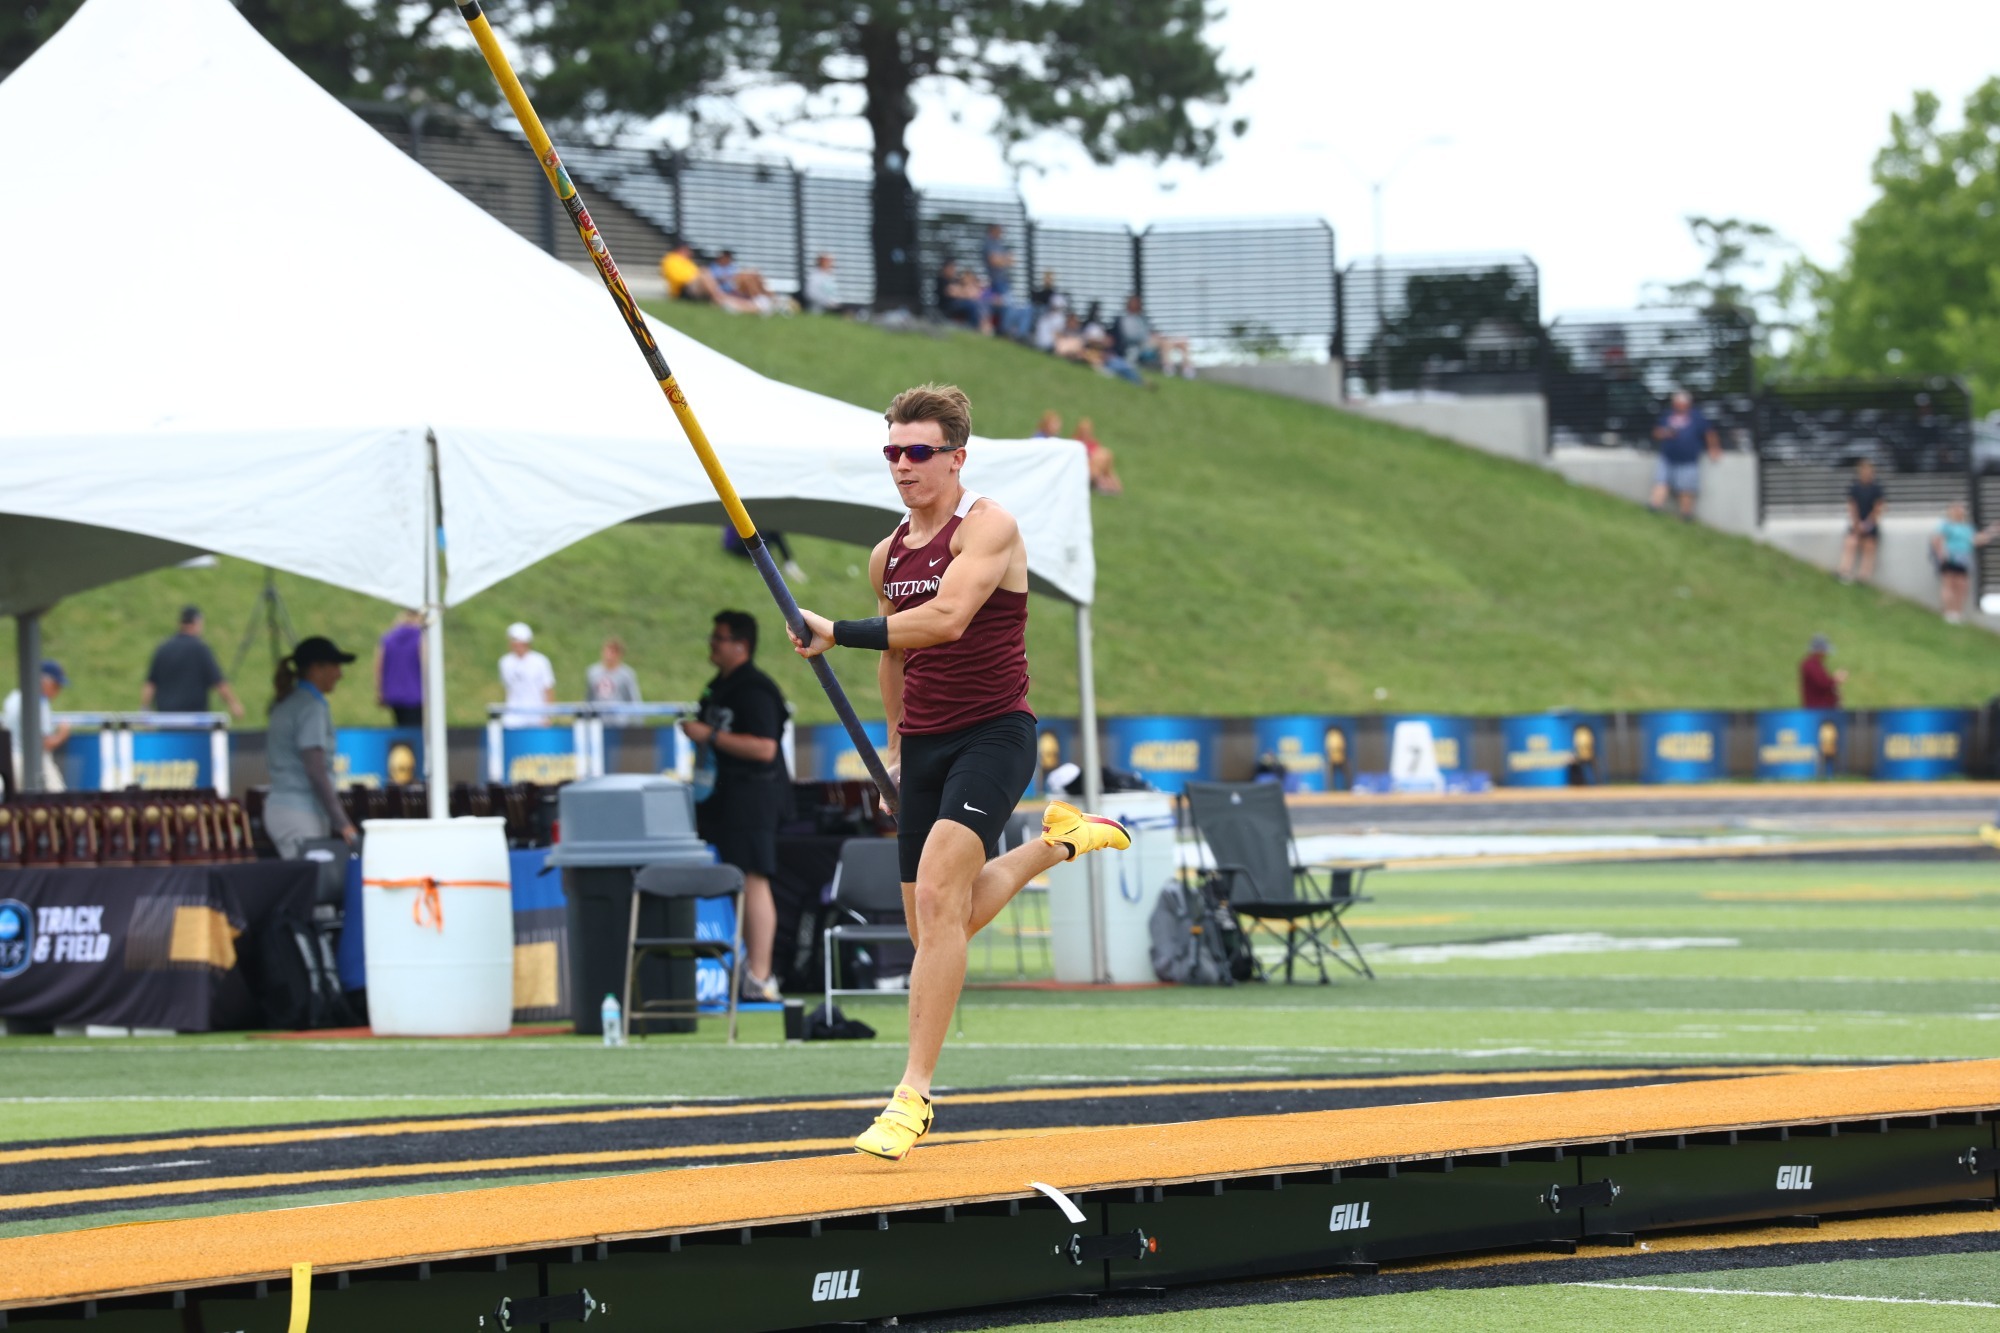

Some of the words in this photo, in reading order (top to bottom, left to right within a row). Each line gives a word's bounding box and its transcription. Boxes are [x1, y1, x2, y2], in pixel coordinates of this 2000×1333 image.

[883, 575, 942, 600] UTZTOW
[37, 905, 104, 934] TRACK
[33, 934, 51, 962] &
[54, 933, 111, 962] FIELD
[1776, 1165, 1813, 1190] GILL
[1329, 1201, 1371, 1232] GILL
[811, 1268, 861, 1302] GILL
